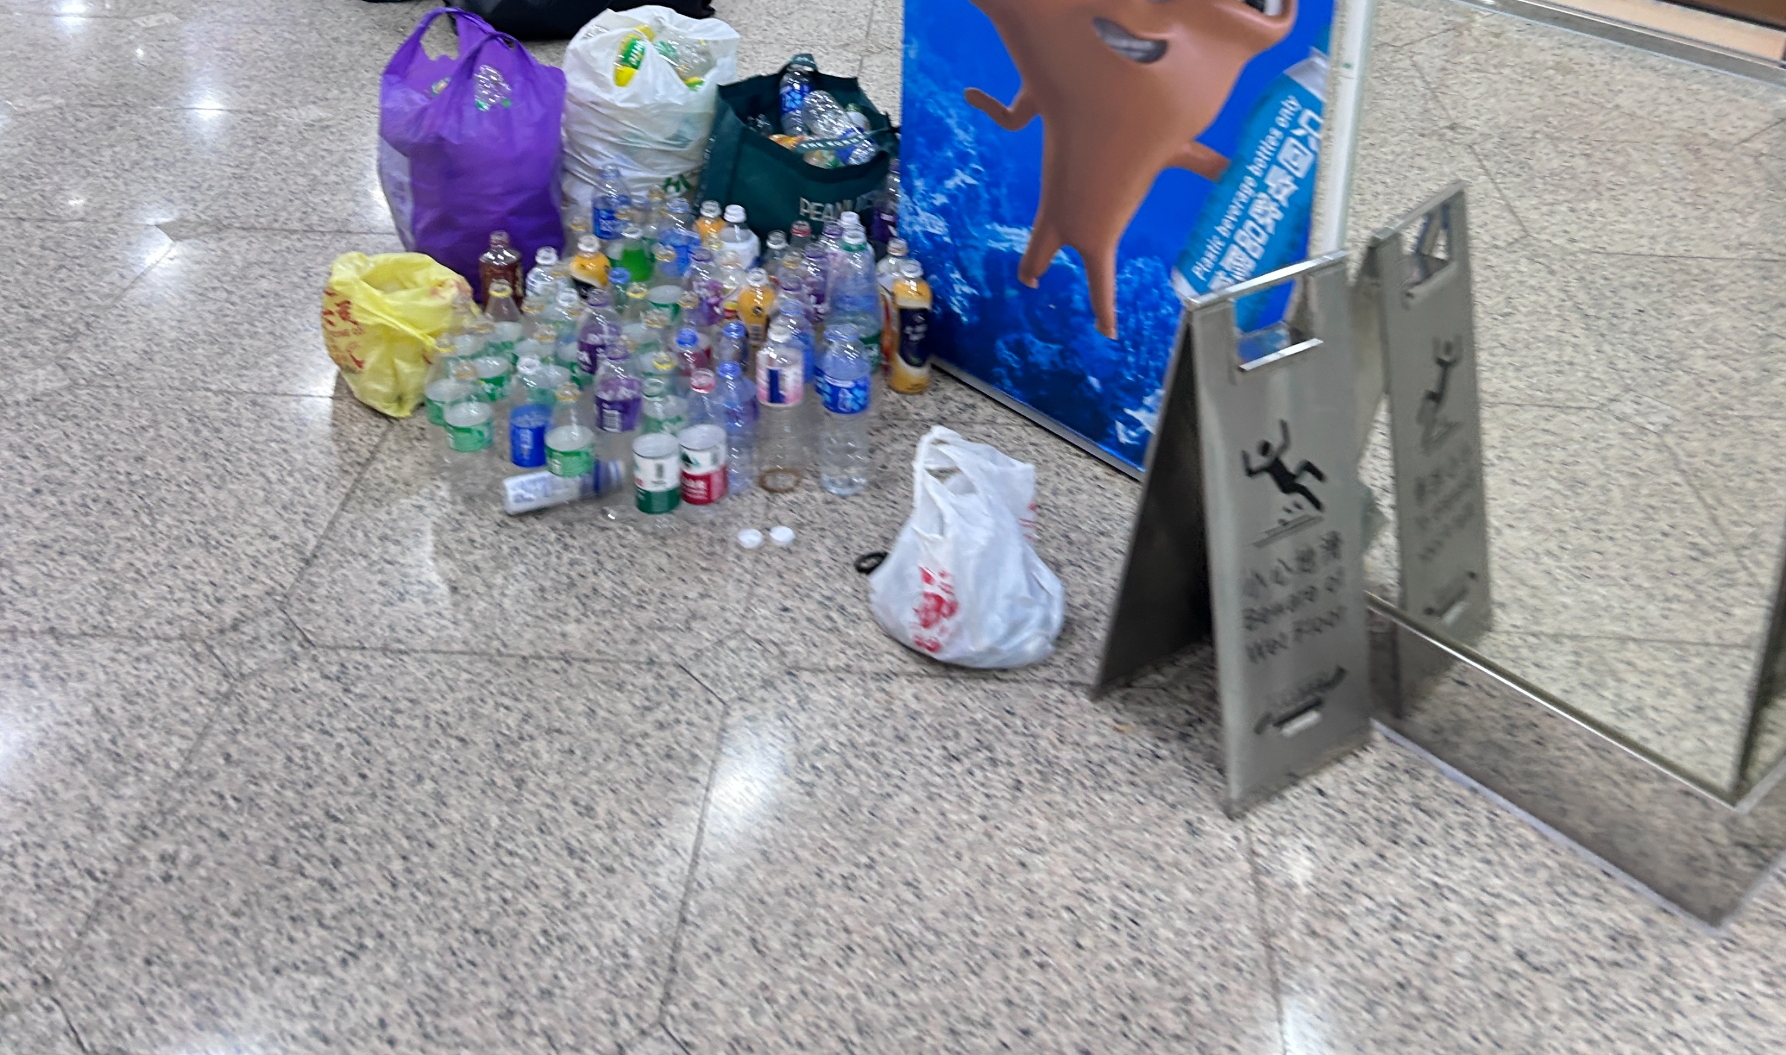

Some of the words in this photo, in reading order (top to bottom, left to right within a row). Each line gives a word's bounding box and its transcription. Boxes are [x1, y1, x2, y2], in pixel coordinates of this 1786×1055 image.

[1191, 235, 1226, 281] Plastic
[1214, 175, 1258, 238] beverage
[1246, 127, 1284, 177] bottles
[1275, 95, 1302, 129] only
